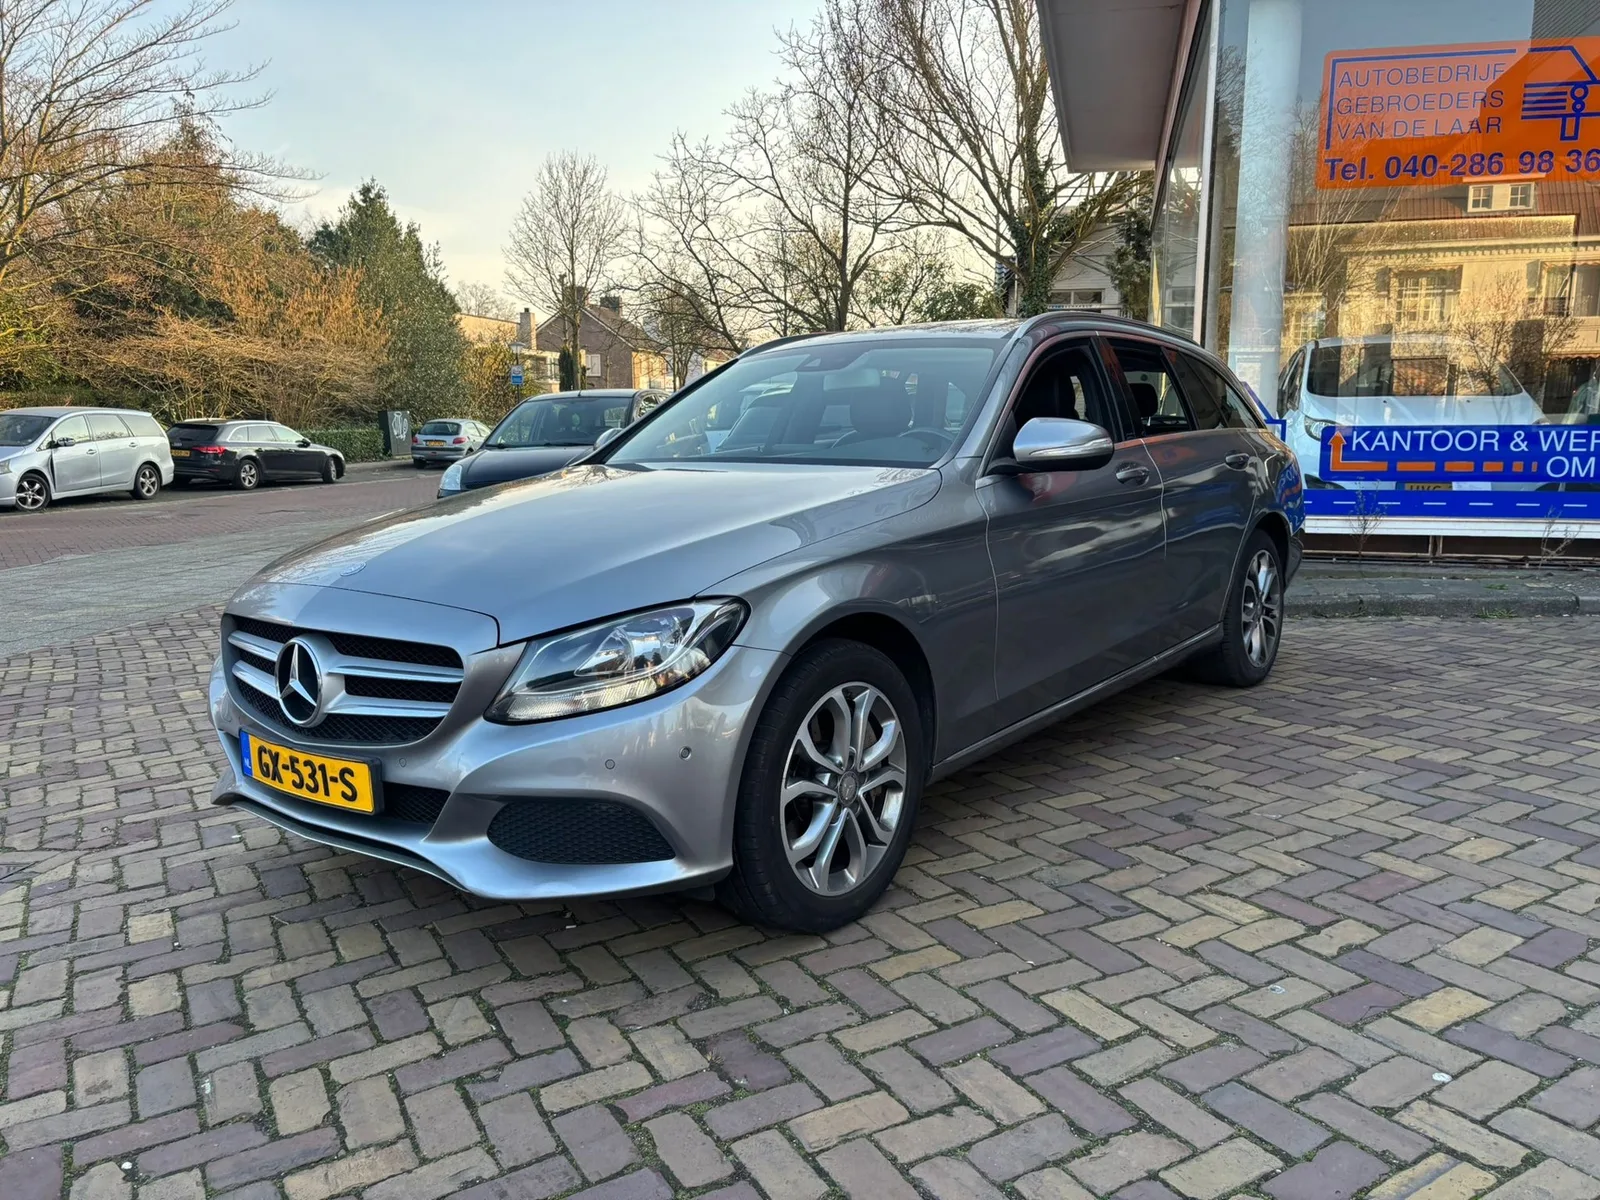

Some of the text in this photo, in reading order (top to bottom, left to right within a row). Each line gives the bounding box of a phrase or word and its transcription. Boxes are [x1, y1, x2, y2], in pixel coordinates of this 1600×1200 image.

[1338, 63, 1507, 88] AUTOBEDRIJF
[1336, 90, 1504, 115] GEBROEDERS
[1337, 116, 1502, 140] VAN DE LAAR
[1324, 149, 1600, 181] Tel. 040-286 98 36
[1351, 430, 1500, 452] KANTOOR
[1509, 430, 1529, 452] &
[1546, 456, 1596, 478] OM
[257, 745, 358, 802] GX-531-S
